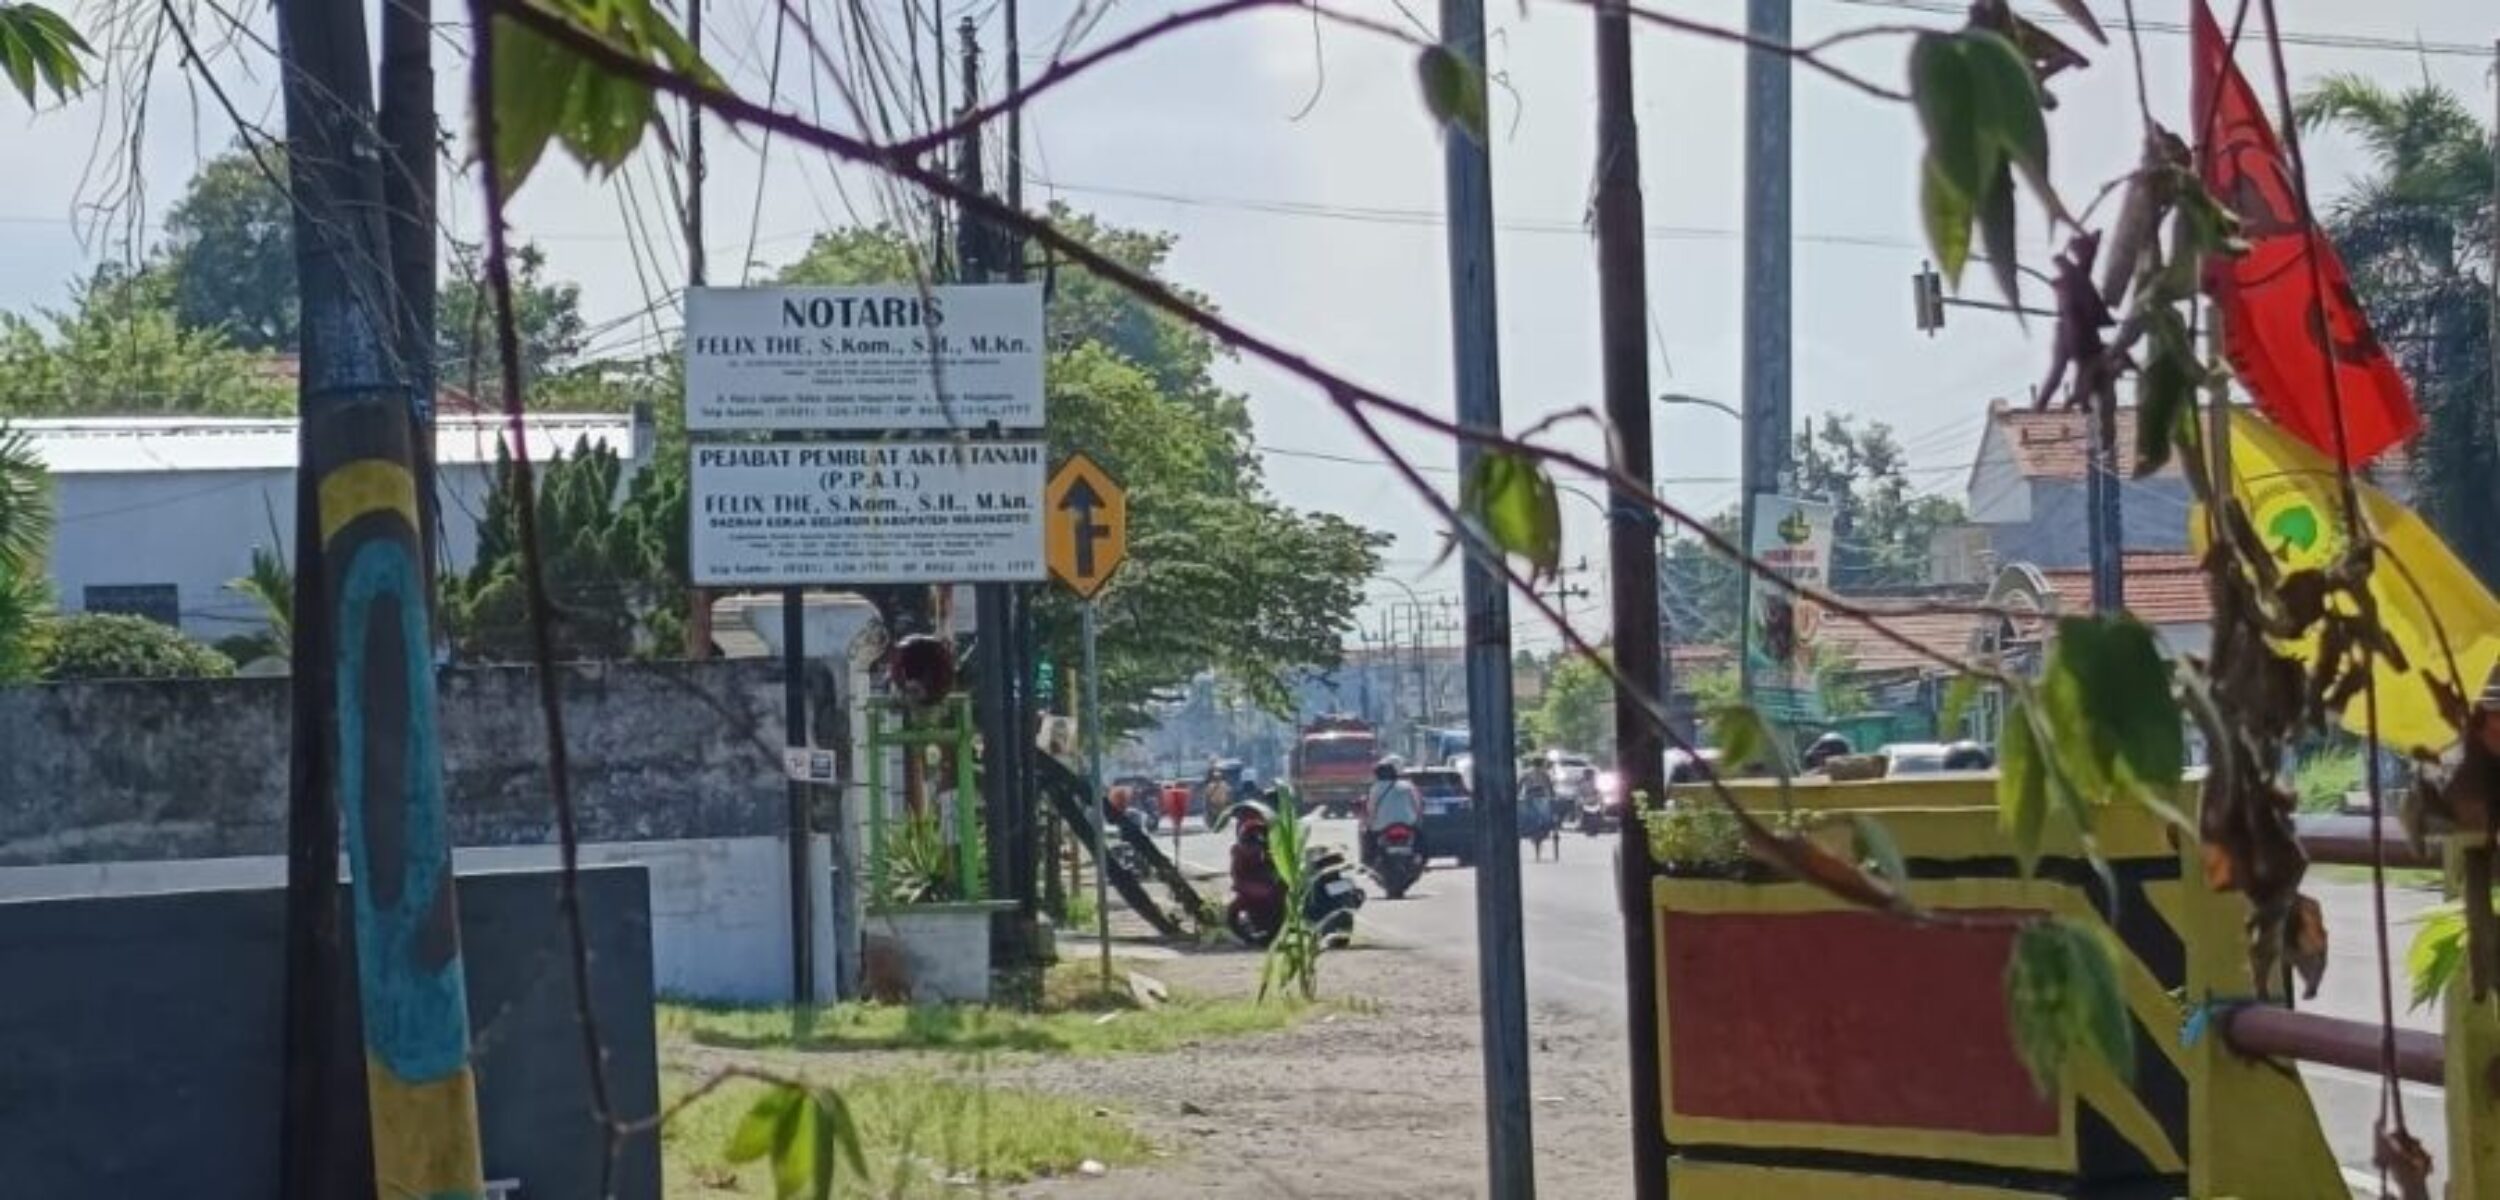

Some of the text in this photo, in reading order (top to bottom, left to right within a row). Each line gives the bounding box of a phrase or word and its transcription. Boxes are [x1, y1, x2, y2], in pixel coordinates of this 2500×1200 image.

[782, 297, 945, 328] NOTARIS
[696, 336, 756, 355] FELIX
[700, 447, 1038, 467] PEJABAT PEMBUAT AKTA TANAH
[819, 470, 920, 492] (P.P.A.T.)
[705, 495, 764, 513] FELIX
